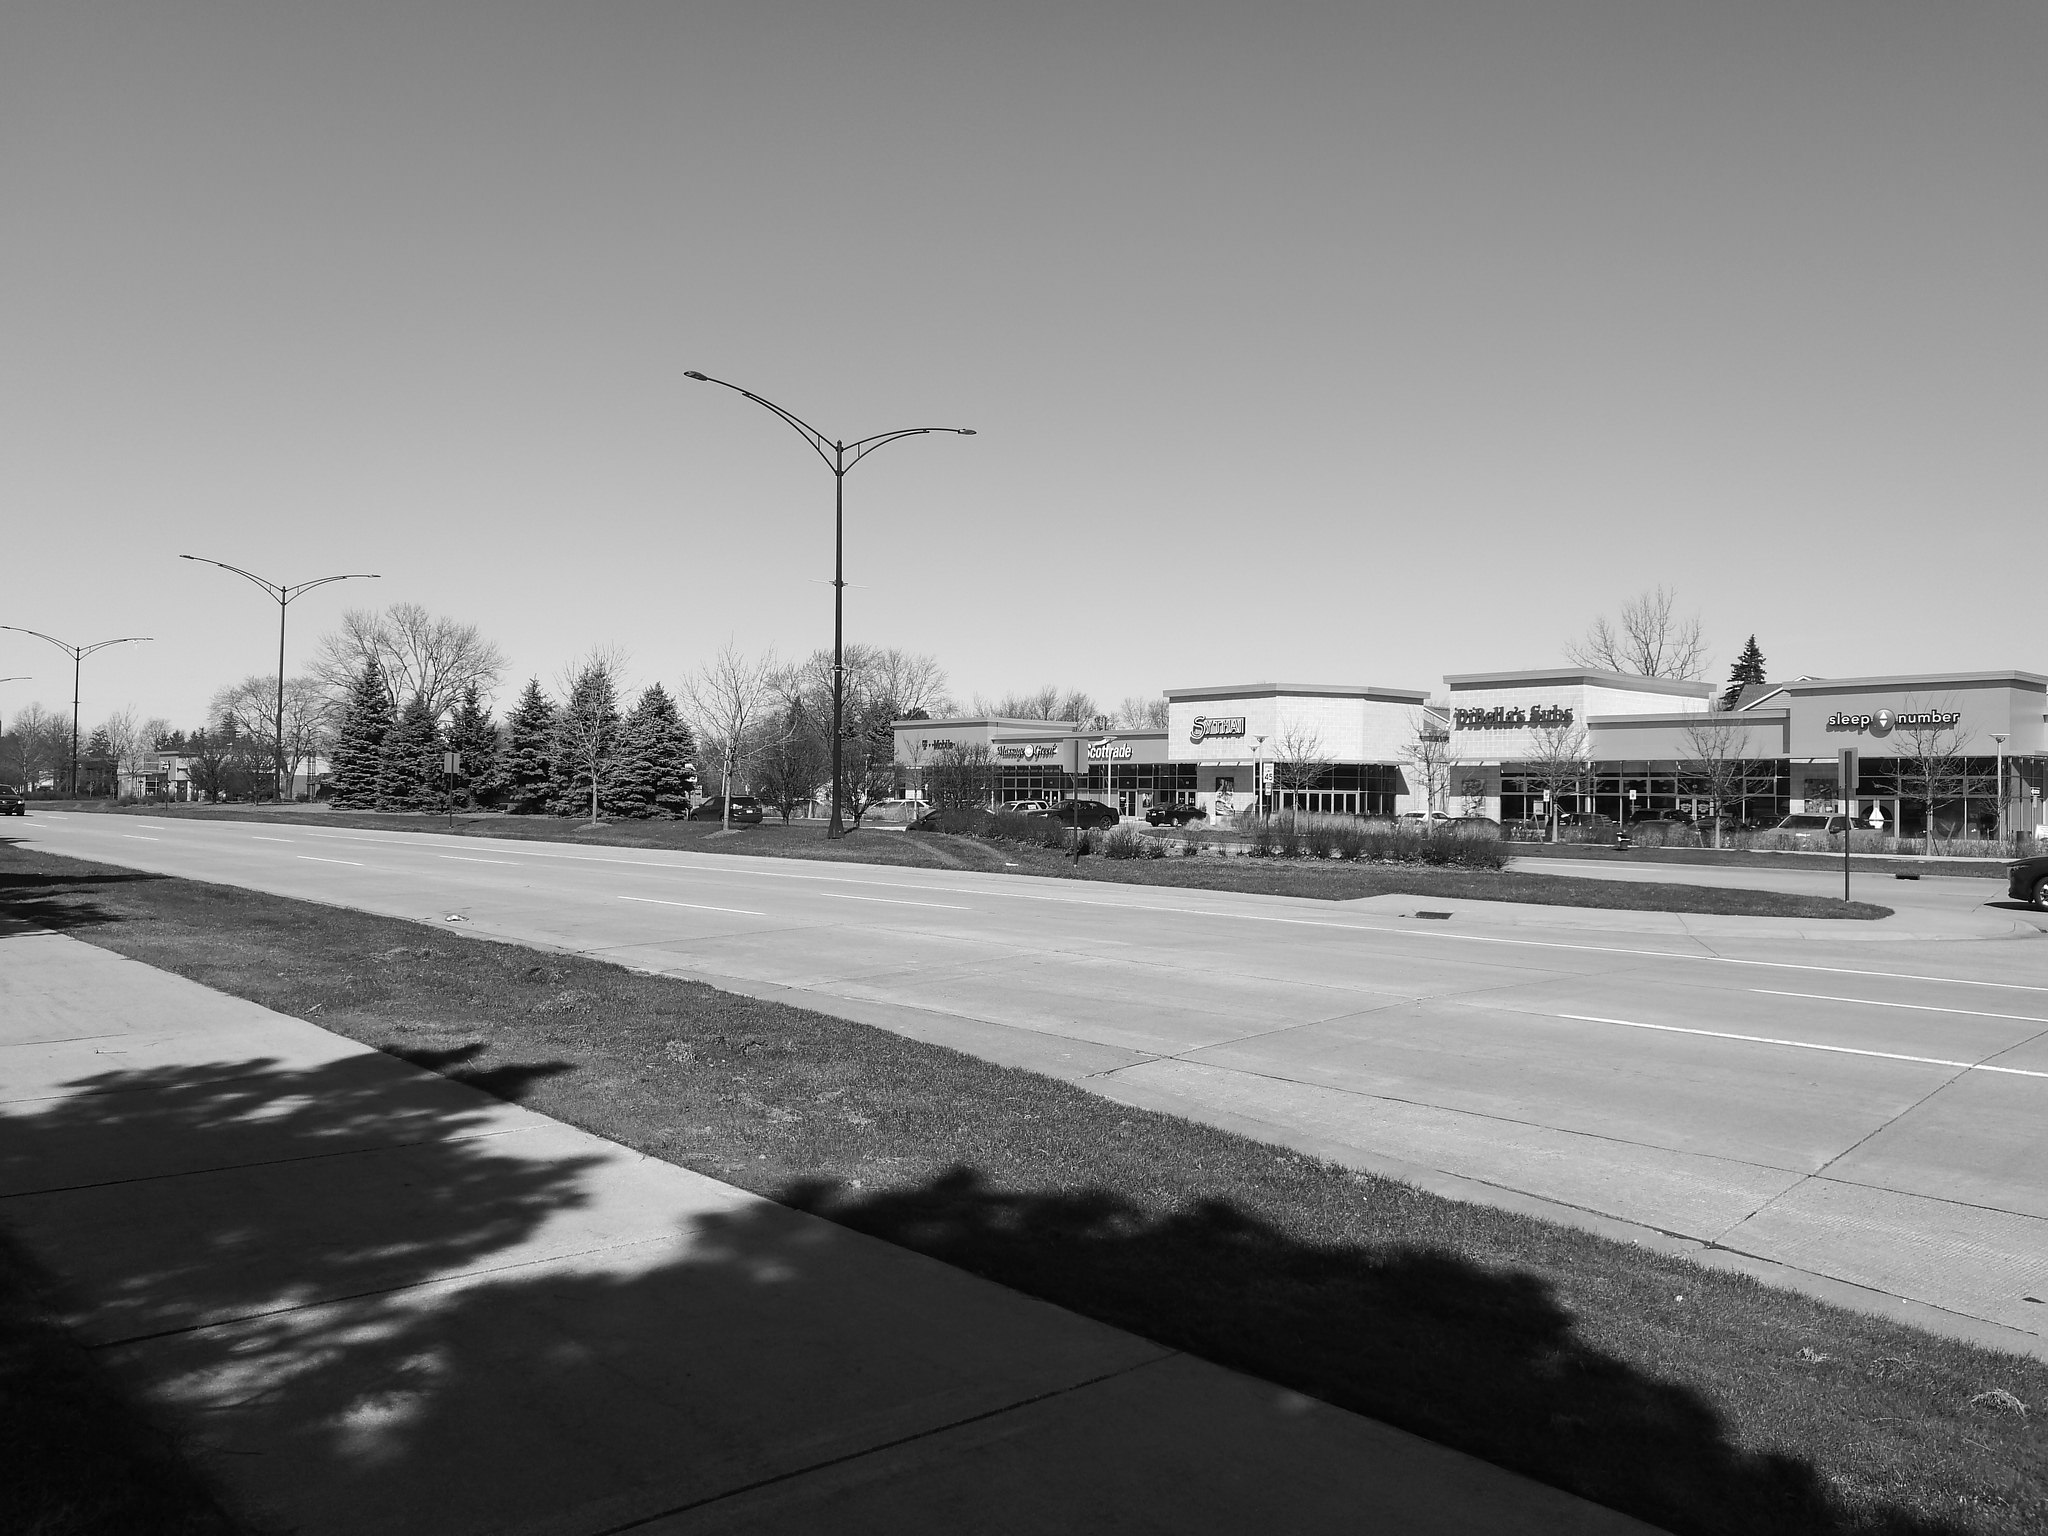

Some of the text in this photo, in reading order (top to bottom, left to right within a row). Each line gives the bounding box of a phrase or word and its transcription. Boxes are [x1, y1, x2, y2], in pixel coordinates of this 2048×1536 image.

[1530, 704, 1574, 724] Subs
[1828, 709, 1961, 729] sleep number
[1264, 773, 1273, 781] 45
